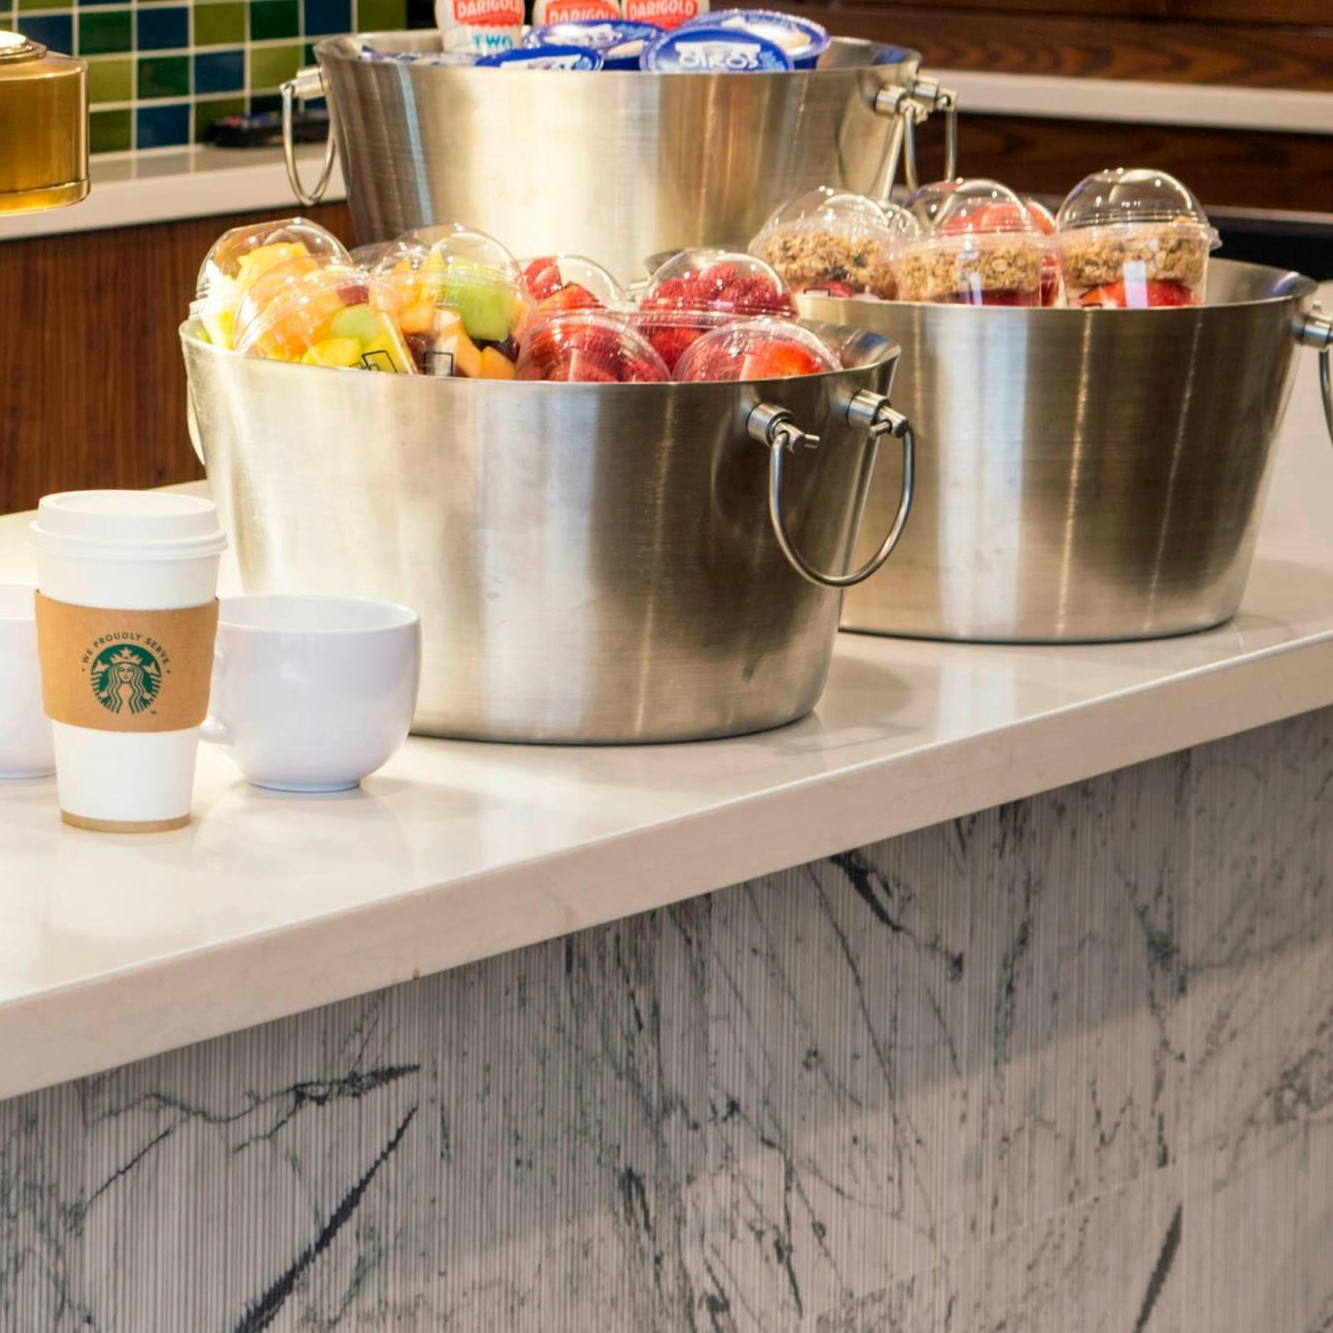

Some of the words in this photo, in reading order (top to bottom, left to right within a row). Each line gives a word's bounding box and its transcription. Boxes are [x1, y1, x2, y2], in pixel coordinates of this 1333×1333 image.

[472, 35, 513, 51] TWO
[81, 647, 94, 664] WE
[93, 631, 143, 649] PROUDLY
[145, 637, 171, 666] SERVE
